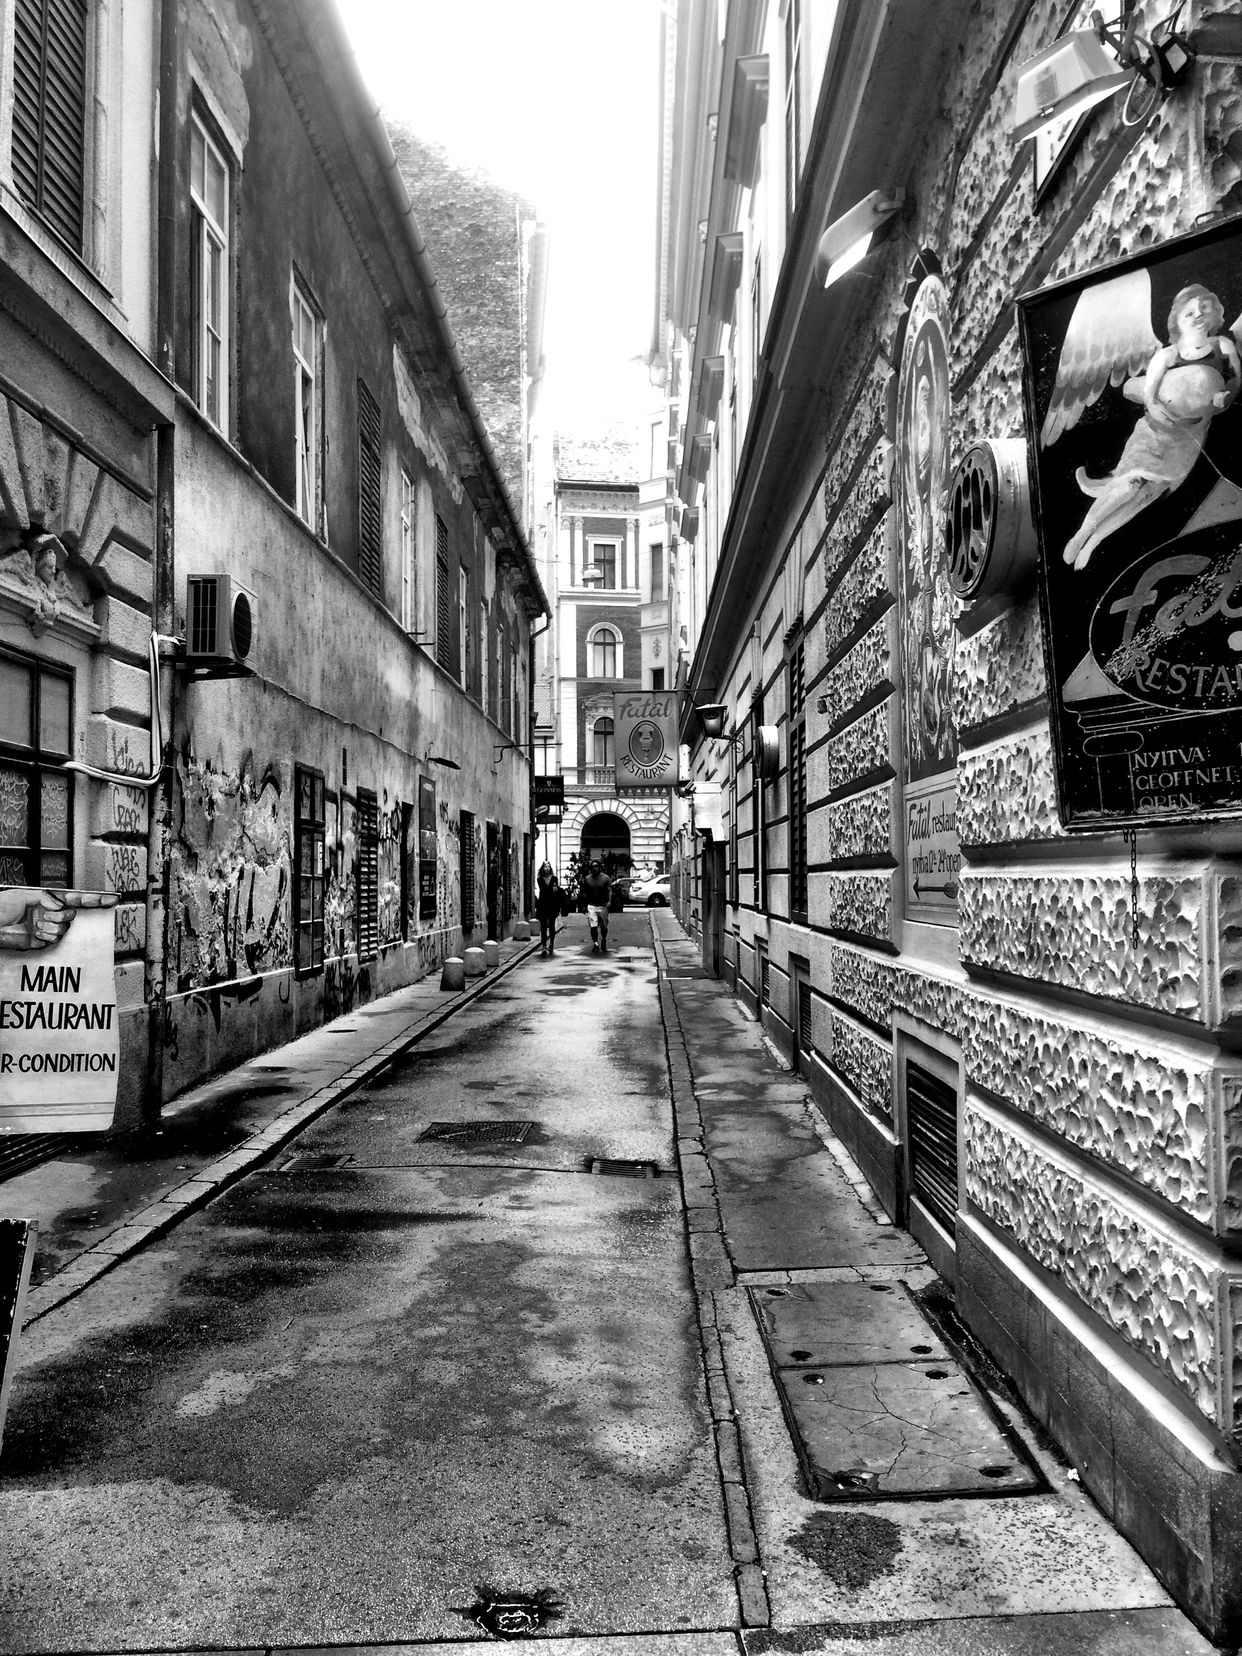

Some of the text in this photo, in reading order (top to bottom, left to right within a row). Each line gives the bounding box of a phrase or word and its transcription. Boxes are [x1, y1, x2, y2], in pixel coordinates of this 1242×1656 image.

[620, 753, 673, 779] RESTAURANT
[1134, 747, 1205, 769] NYITVA
[20, 964, 81, 993] MAIN
